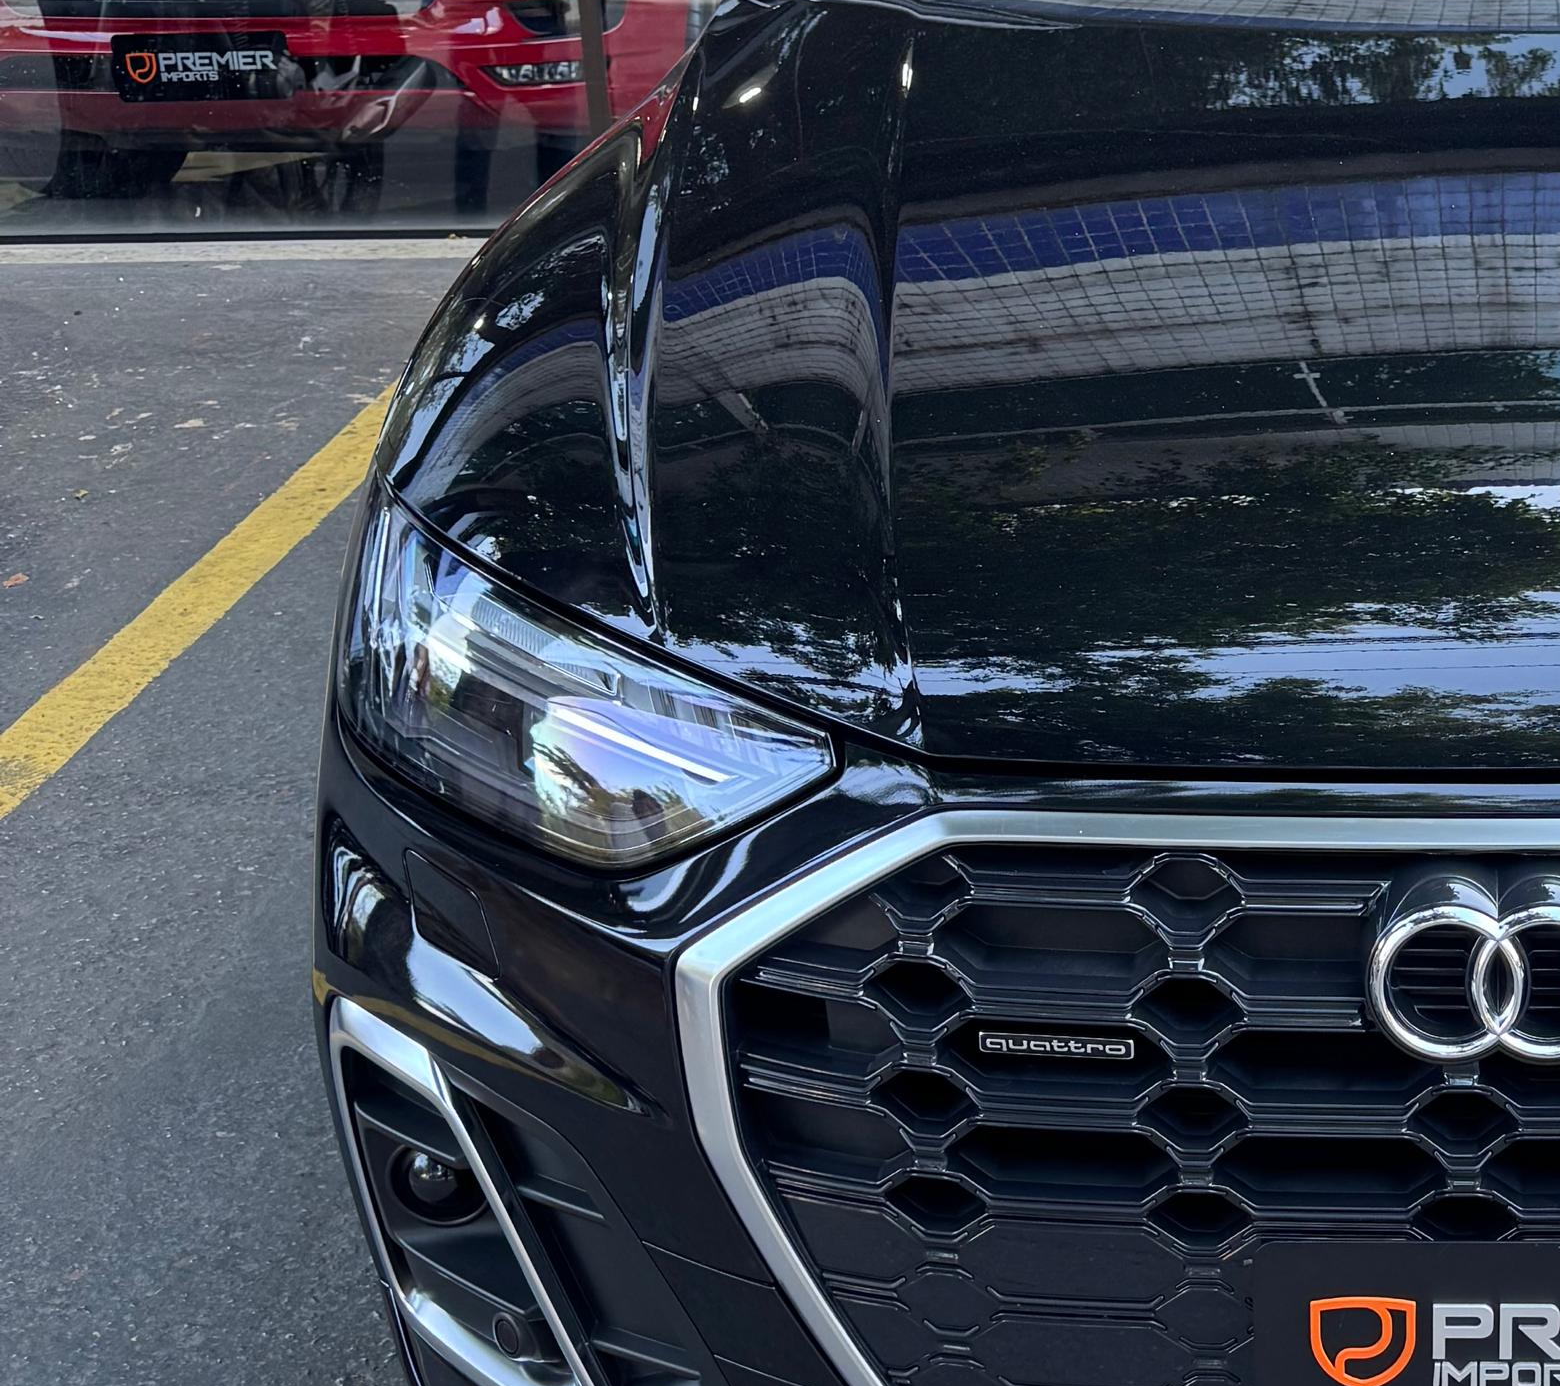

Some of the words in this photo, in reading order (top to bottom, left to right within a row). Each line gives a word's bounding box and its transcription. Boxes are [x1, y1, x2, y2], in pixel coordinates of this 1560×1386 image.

[158, 50, 277, 71] PREMIER
[161, 71, 219, 82] IMPORTS
[985, 1038, 1126, 1055] quattro
